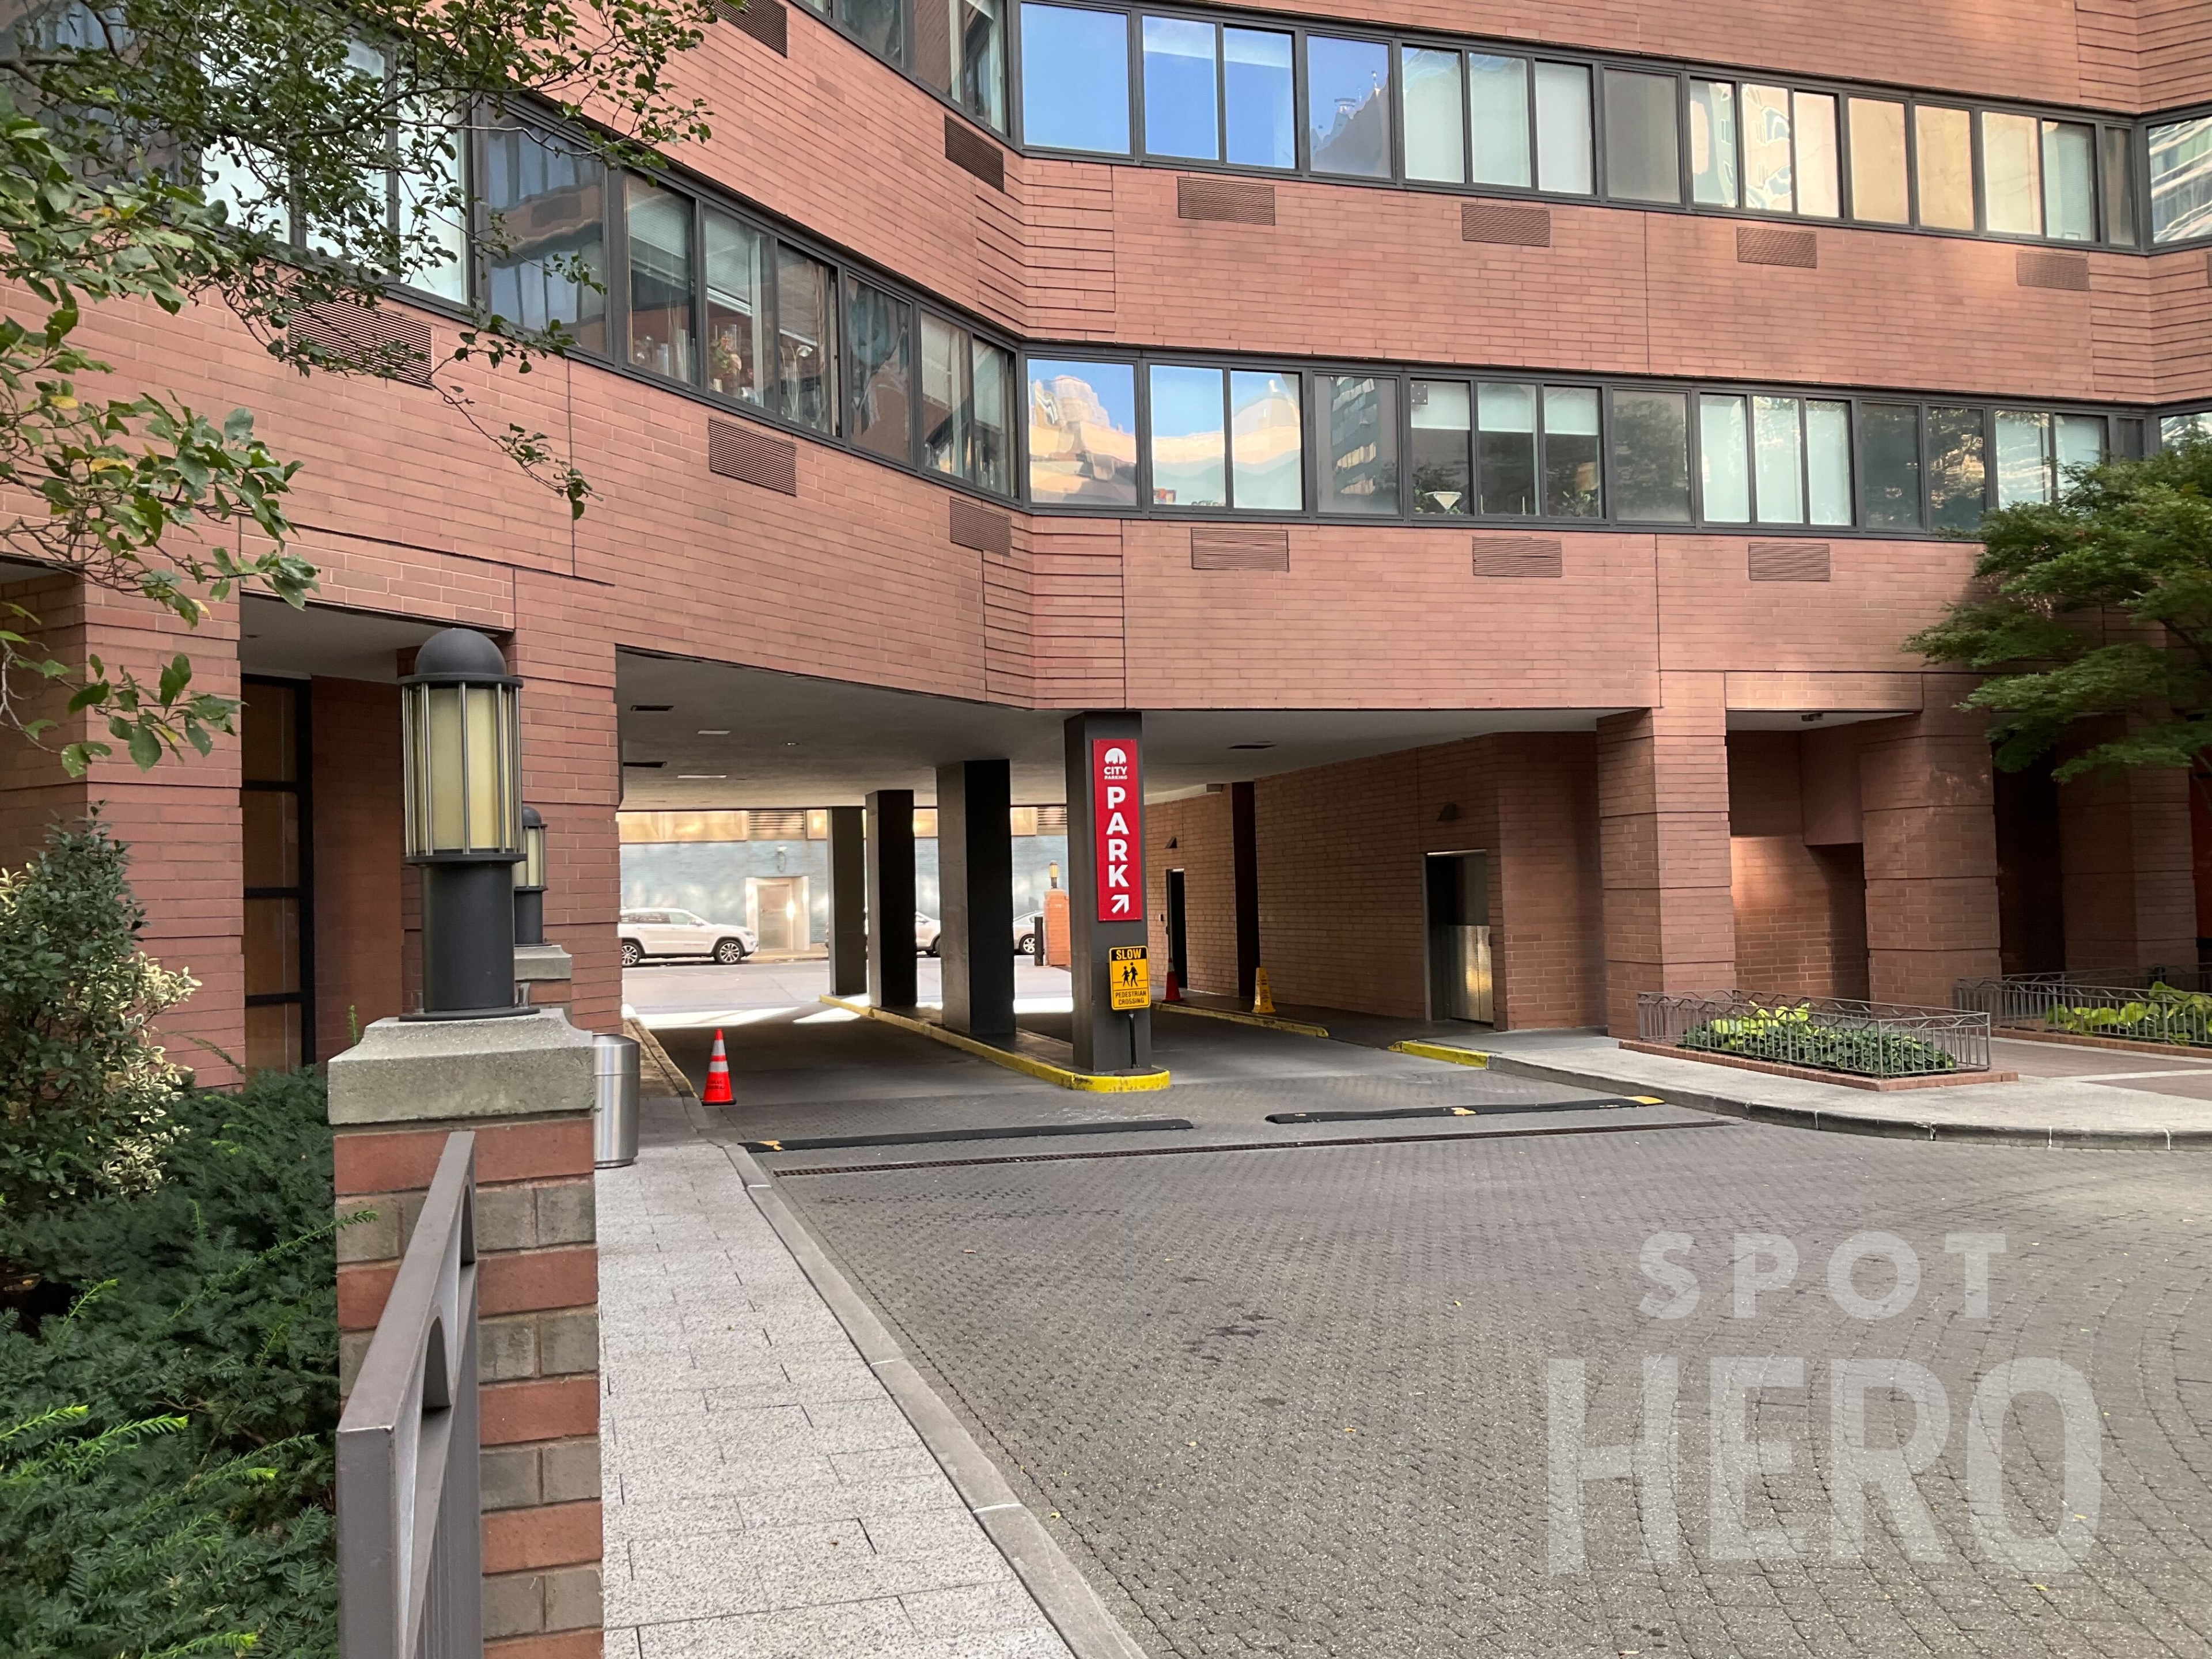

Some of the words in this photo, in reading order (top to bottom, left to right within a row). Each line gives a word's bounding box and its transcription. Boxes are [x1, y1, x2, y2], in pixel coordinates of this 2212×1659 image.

[1104, 766, 1127, 775] CITY
[1106, 786, 1130, 887] PARK
[1116, 948, 1141, 960] SLOW
[1115, 990, 1146, 998] PEDESTRIAN
[1118, 997, 1144, 1005] CROSSING
